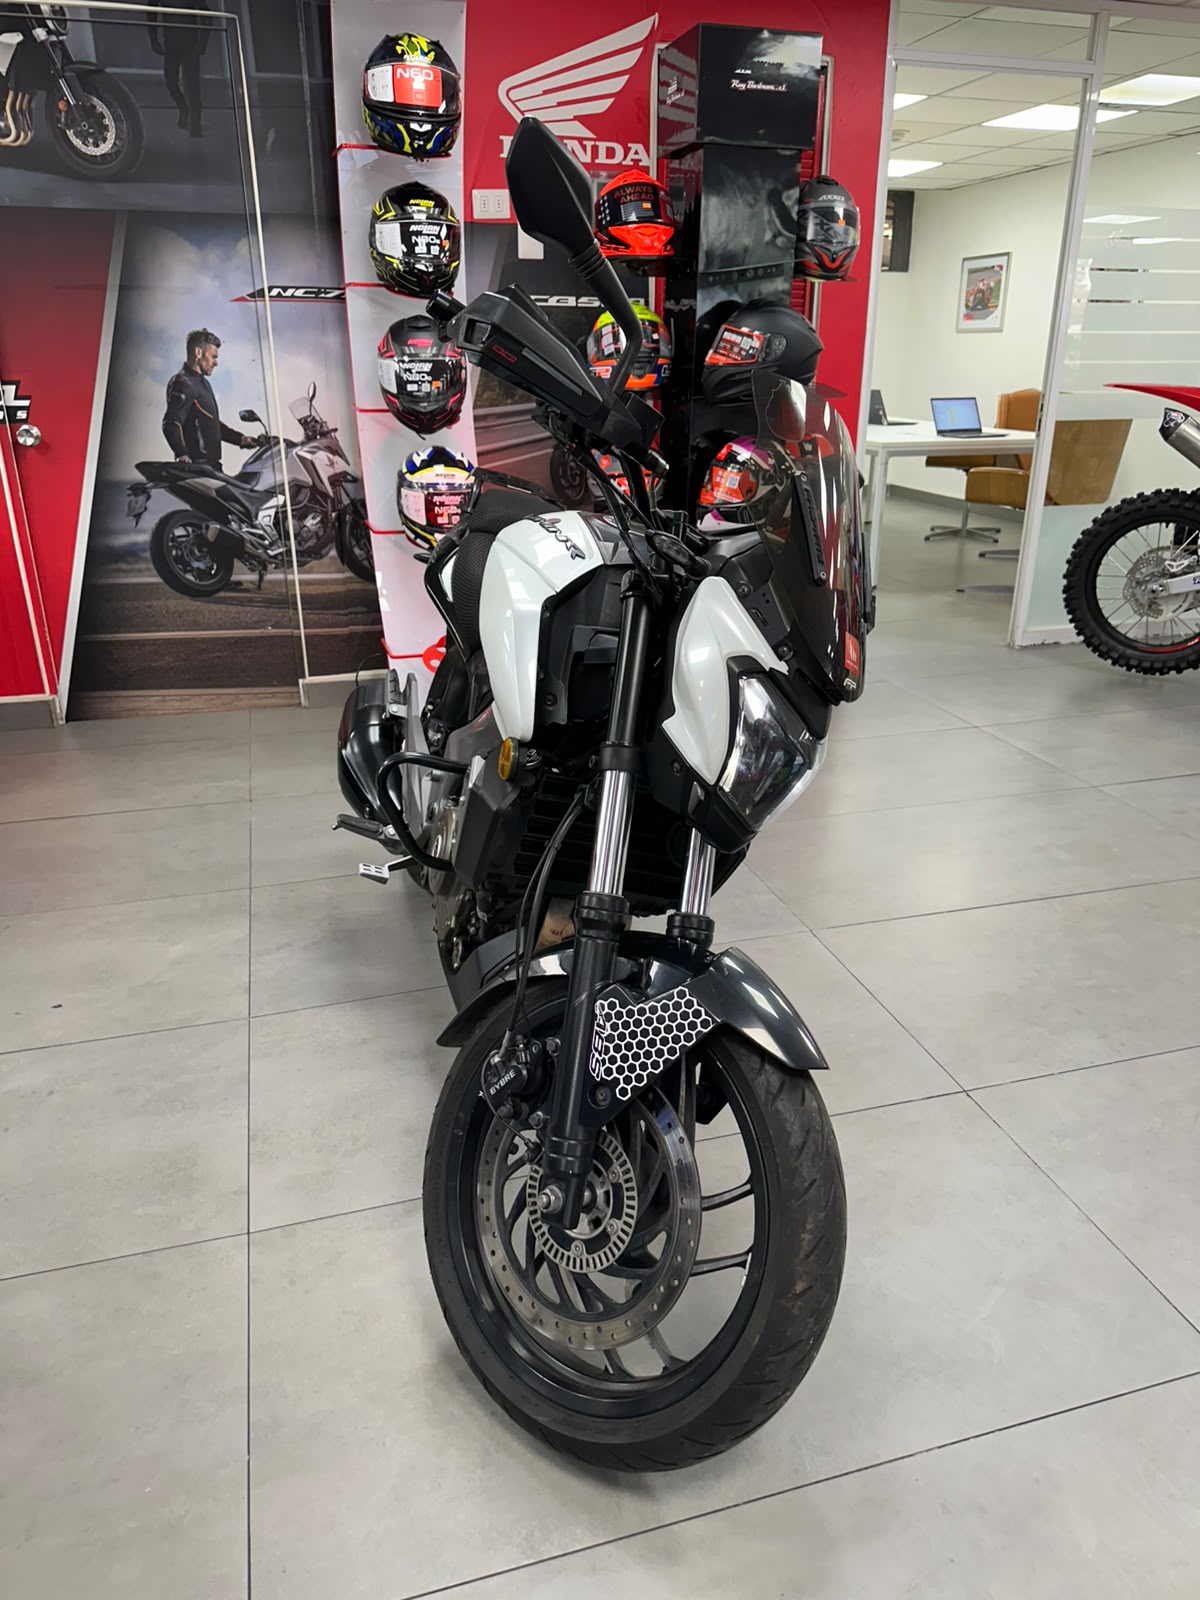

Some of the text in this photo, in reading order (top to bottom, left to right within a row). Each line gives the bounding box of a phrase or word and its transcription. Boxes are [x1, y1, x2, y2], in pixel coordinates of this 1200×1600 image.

[614, 186, 653, 199] ALWAYS
[620, 193, 654, 203] AHEAD
[409, 224, 440, 235] NOLAN
[400, 362, 433, 372] NOLAN
[489, 1069, 517, 1095] BYBRE
